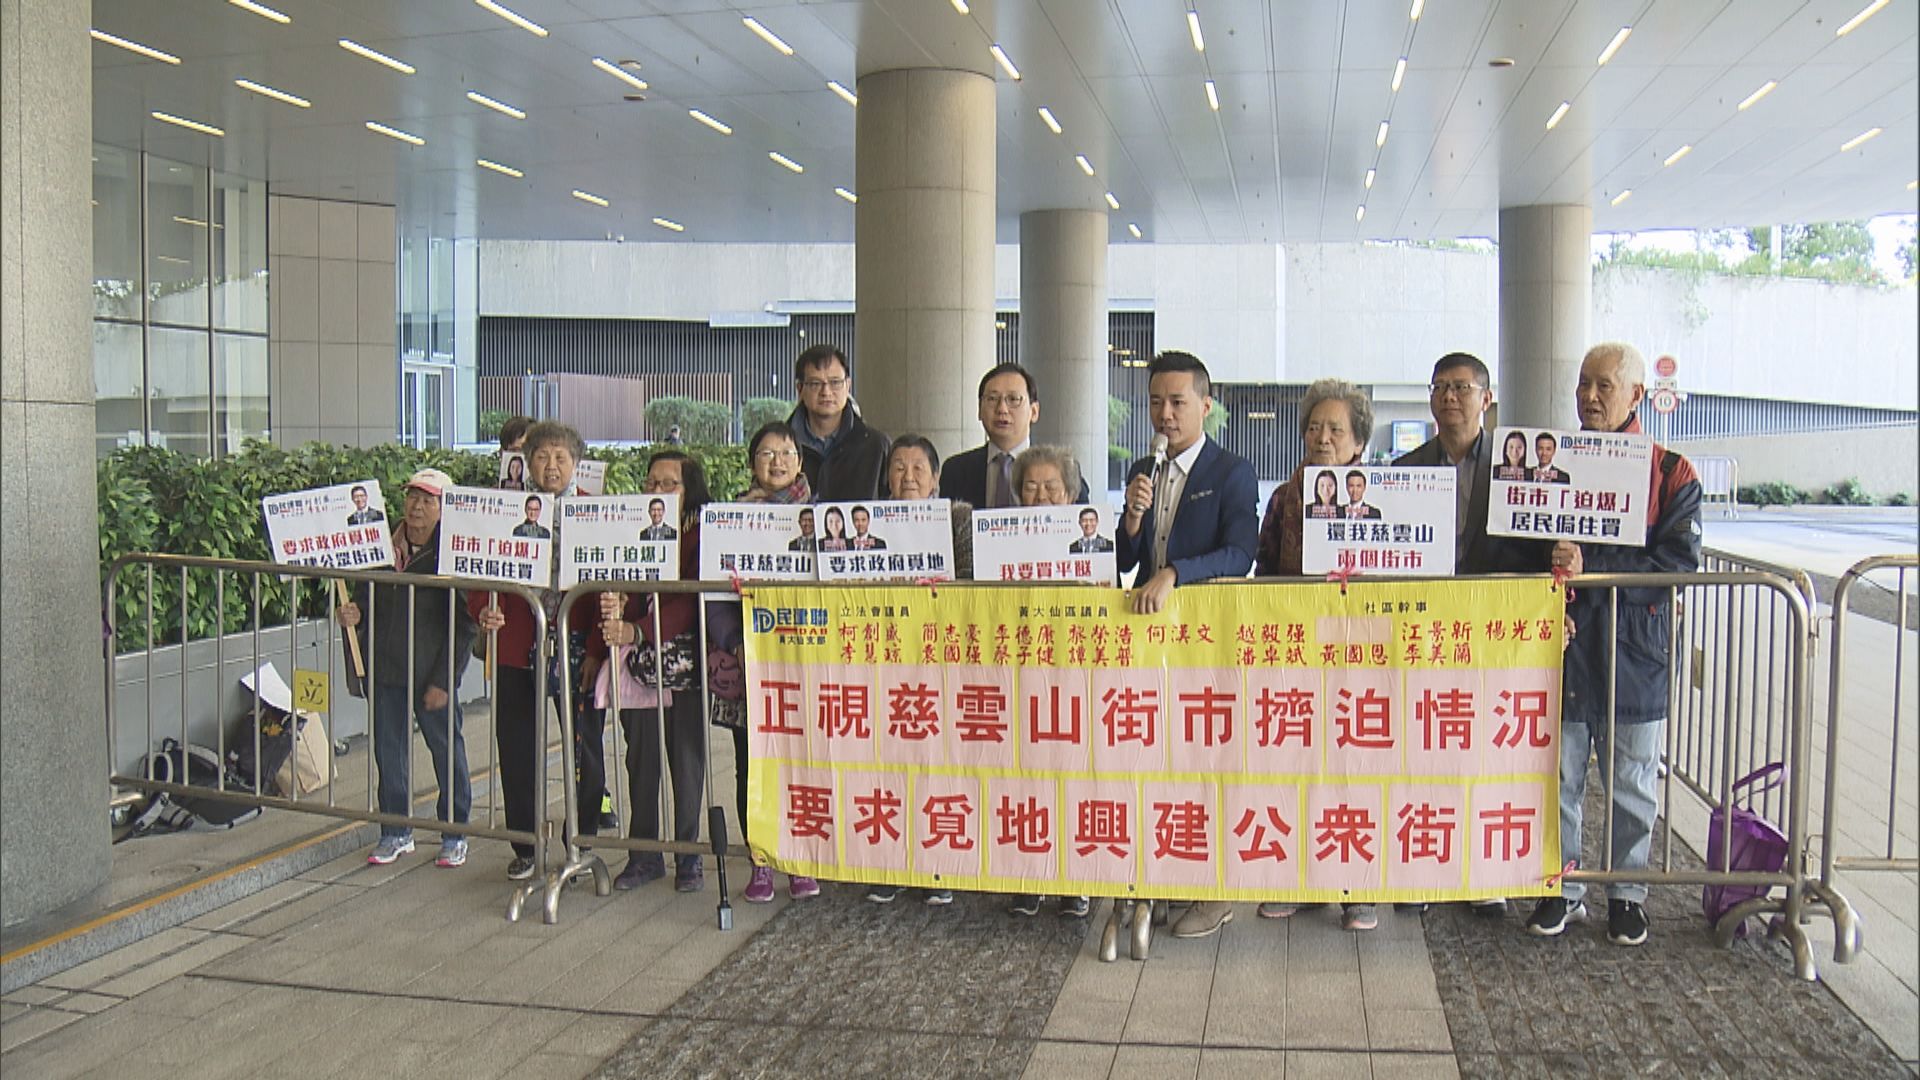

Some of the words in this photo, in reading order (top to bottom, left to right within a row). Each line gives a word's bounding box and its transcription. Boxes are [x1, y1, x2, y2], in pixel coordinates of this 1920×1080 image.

[1658, 395, 1672, 408] 10
[1327, 522, 1434, 543] 還我慈雲山
[1337, 548, 1422, 569] 兩個街市
[777, 607, 828, 626] 民建聯
[841, 606, 909, 618] 立法會議員
[1365, 602, 1427, 614] 社區幹事
[799, 627, 828, 635] DAB
[1146, 623, 1215, 645] 何漢文
[1402, 620, 1473, 642] 江景新
[1486, 618, 1555, 641] 楊光富
[757, 680, 1552, 752] 正視慈雲山街市擠迫情況
